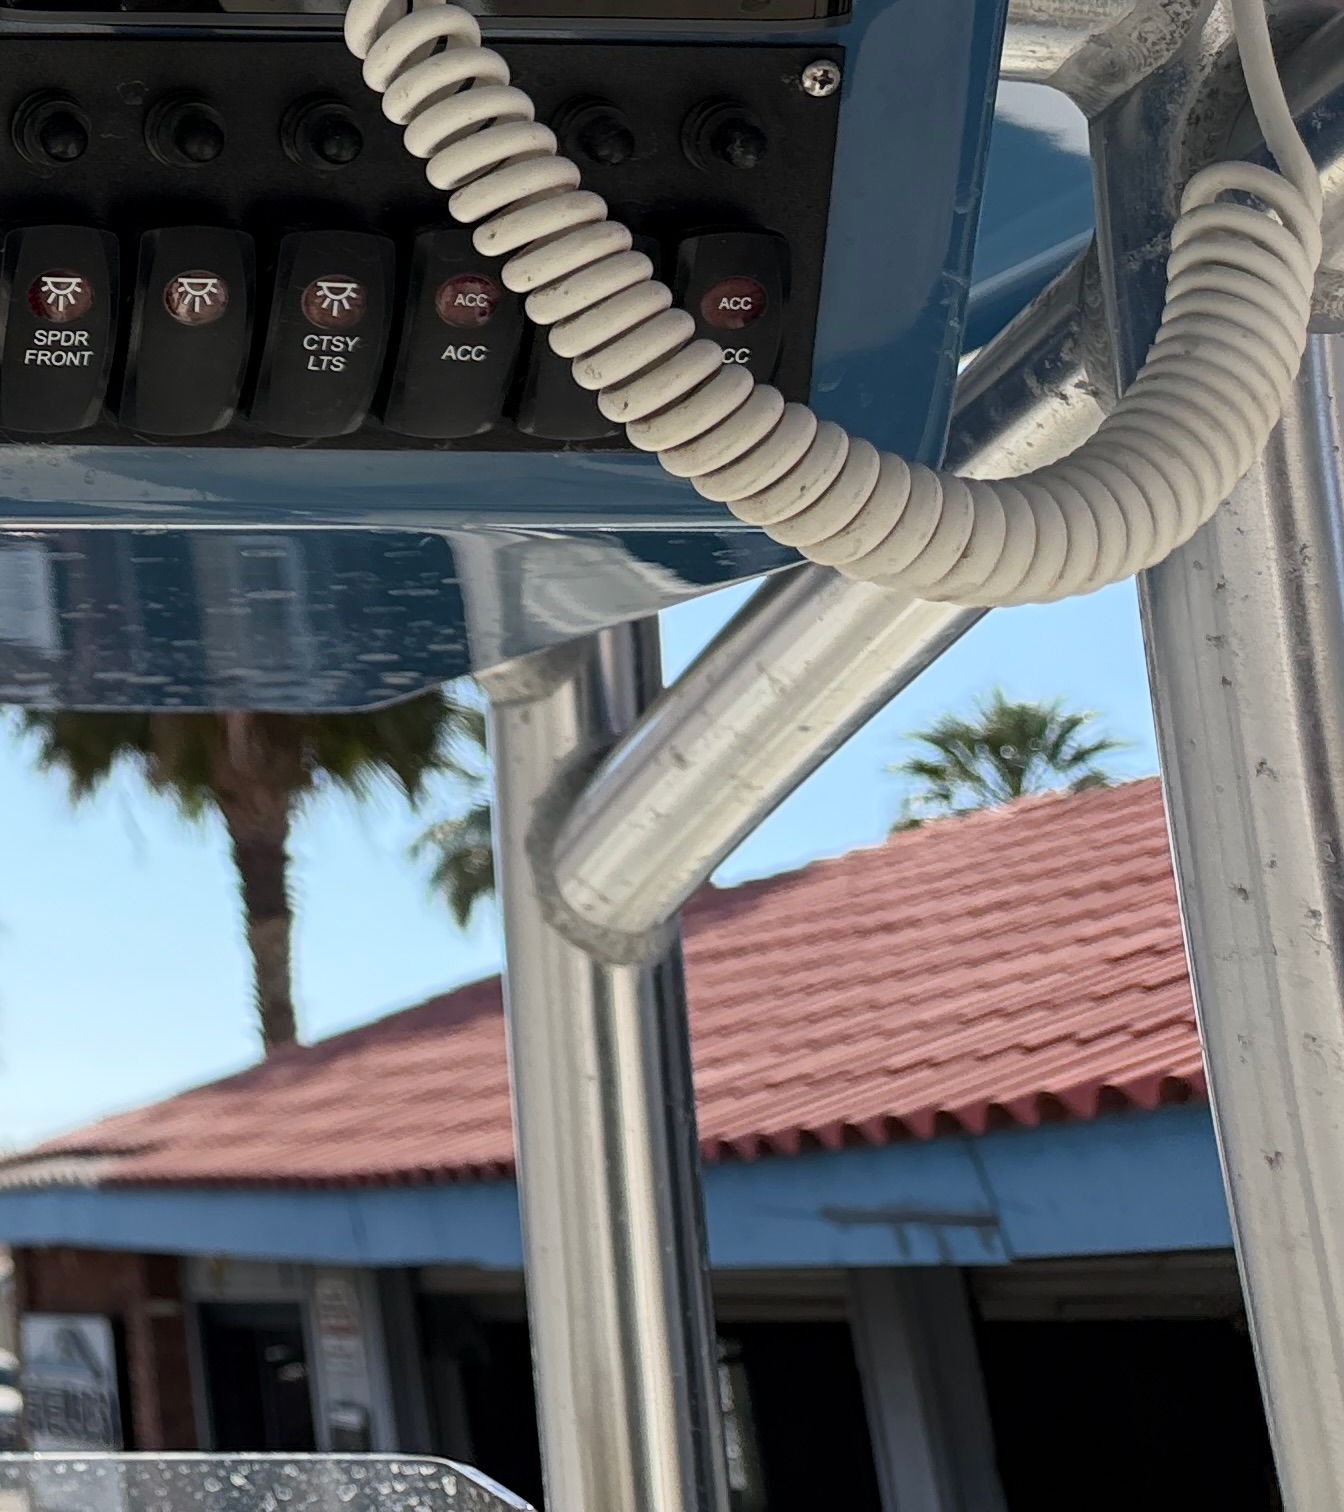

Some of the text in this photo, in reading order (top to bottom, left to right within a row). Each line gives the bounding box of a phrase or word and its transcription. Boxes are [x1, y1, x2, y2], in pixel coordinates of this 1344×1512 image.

[453, 293, 489, 308] ACC
[718, 296, 752, 311] ACC
[32, 329, 89, 347] SPDR
[302, 334, 360, 353] CTSY
[23, 349, 94, 367] FRONT
[440, 345, 489, 362] ACC
[721, 348, 751, 364] CC
[307, 355, 348, 372] LTS
